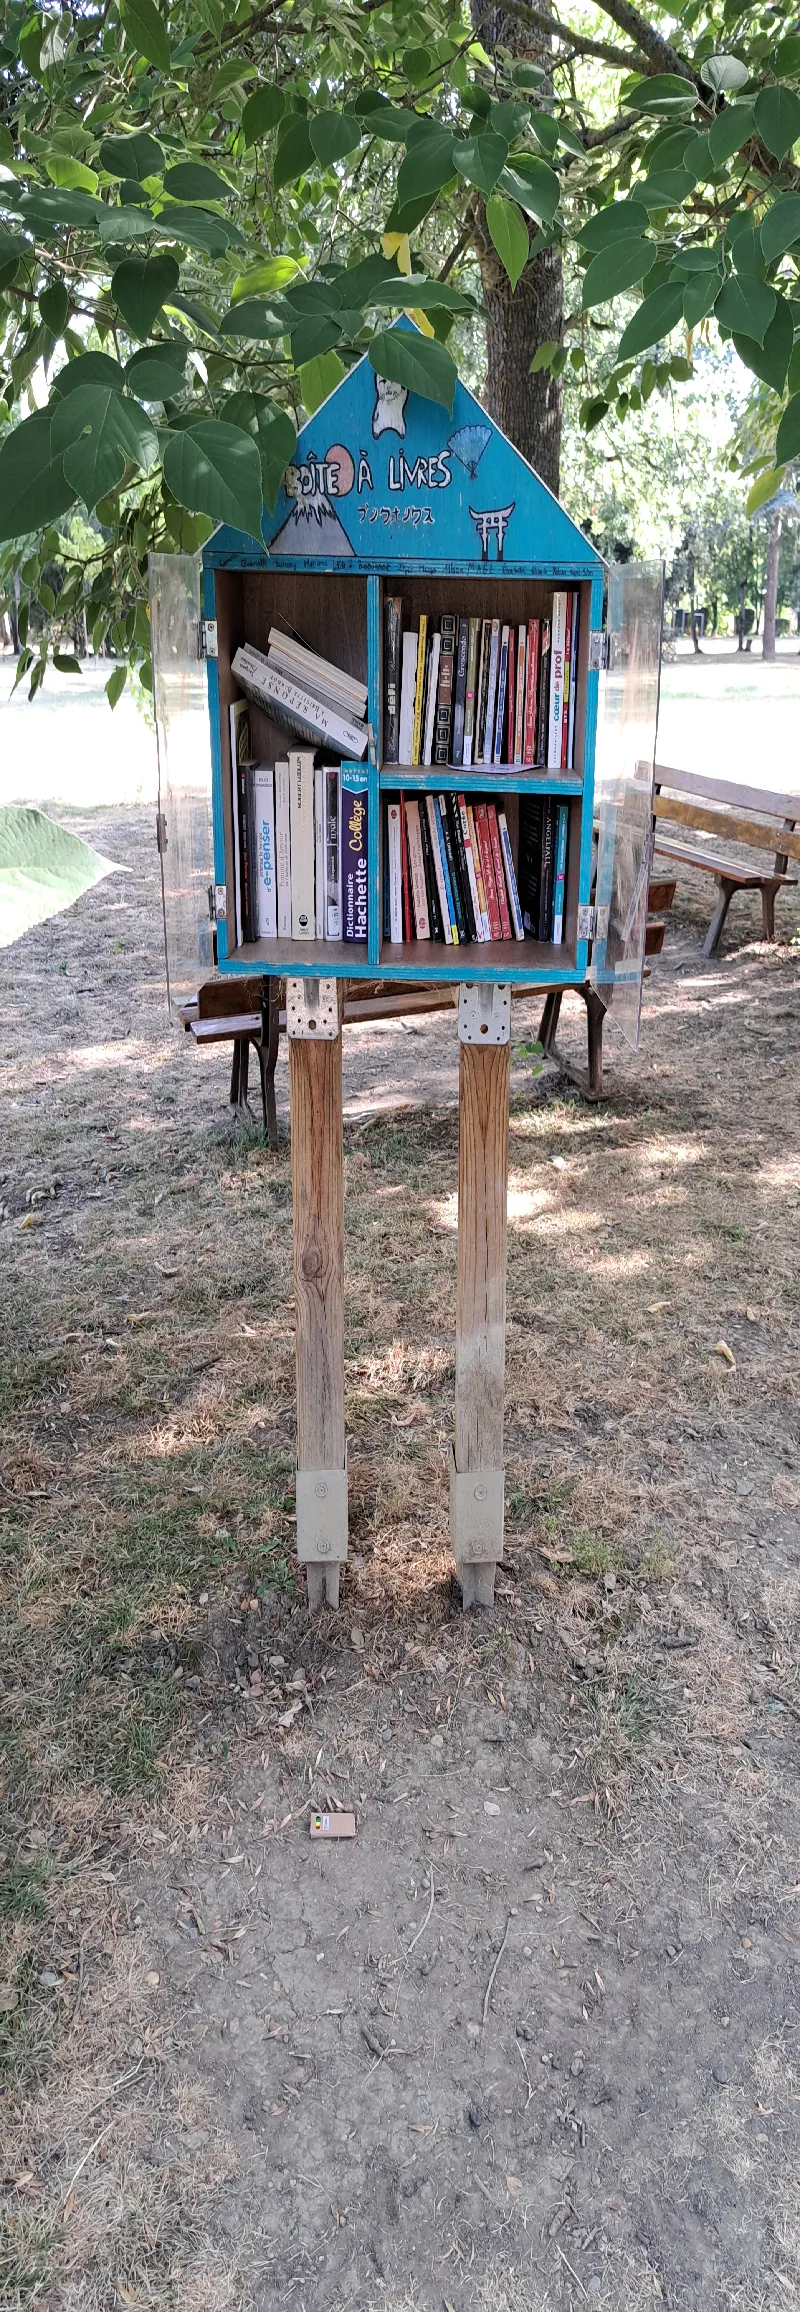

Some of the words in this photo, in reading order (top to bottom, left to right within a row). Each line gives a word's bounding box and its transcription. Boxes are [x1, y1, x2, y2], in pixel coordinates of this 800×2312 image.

[284, 451, 341, 498] BOÎTE
[358, 449, 374, 494] À
[457, 636, 467, 677] Crescendo
[554, 650, 562, 678] prof
[315, 713, 329, 727] MA
[343, 774, 359, 782] 10-15
[327, 815, 338, 847] Finale
[349, 800, 365, 852] Collège
[262, 820, 273, 886] e-penser
[355, 858, 366, 938] Hachette
